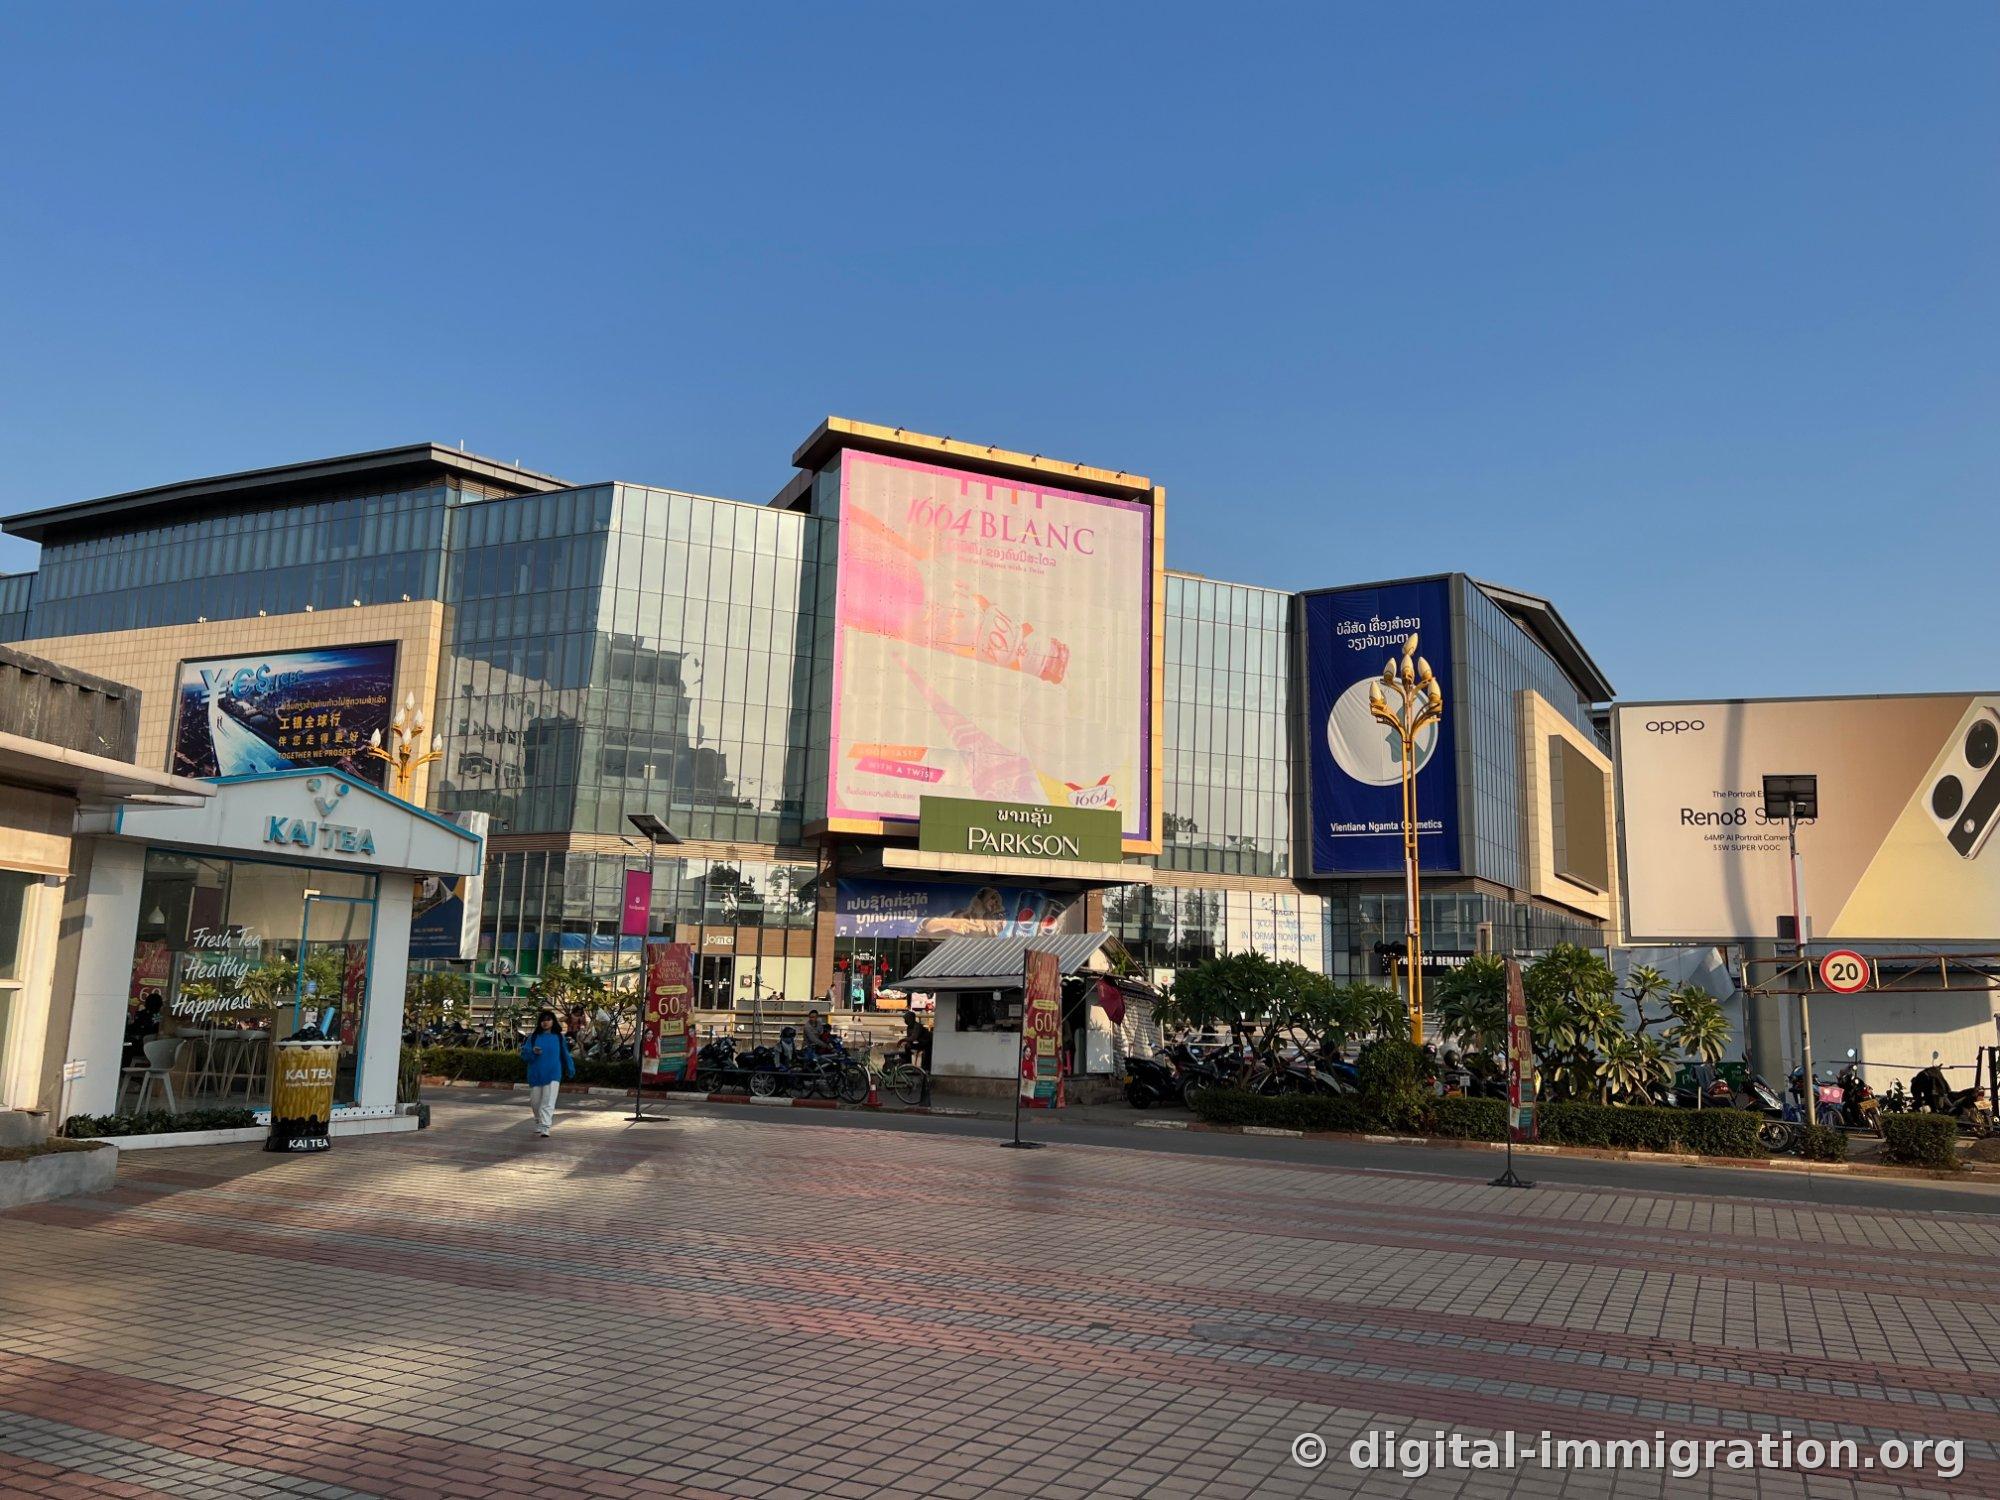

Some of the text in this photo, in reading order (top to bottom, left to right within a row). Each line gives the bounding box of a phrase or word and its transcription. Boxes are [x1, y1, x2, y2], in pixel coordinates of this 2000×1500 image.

[980, 510, 1096, 555] BLANC
[278, 751, 312, 760] TOGETHER
[325, 748, 357, 757] PROSPER
[1712, 790, 1726, 798] The
[1727, 790, 1756, 798] Portrait
[1330, 819, 1443, 832] Vientiane Ngamta Cometics
[1680, 807, 1747, 826] Reno8
[263, 816, 377, 855] KAI TEA
[967, 827, 1080, 857] PARKSON
[1703, 833, 1725, 842] 64MP
[1726, 833, 1734, 841] AI
[1735, 833, 1762, 842] Portrait
[192, 926, 262, 948] Fresh Tea
[185, 956, 250, 989] Healthy
[1831, 962, 1859, 981] 20
[171, 994, 252, 1021] Happiness
[286, 1069, 333, 1080] KAI TEA
[288, 1138, 329, 1148] KAI TEA
